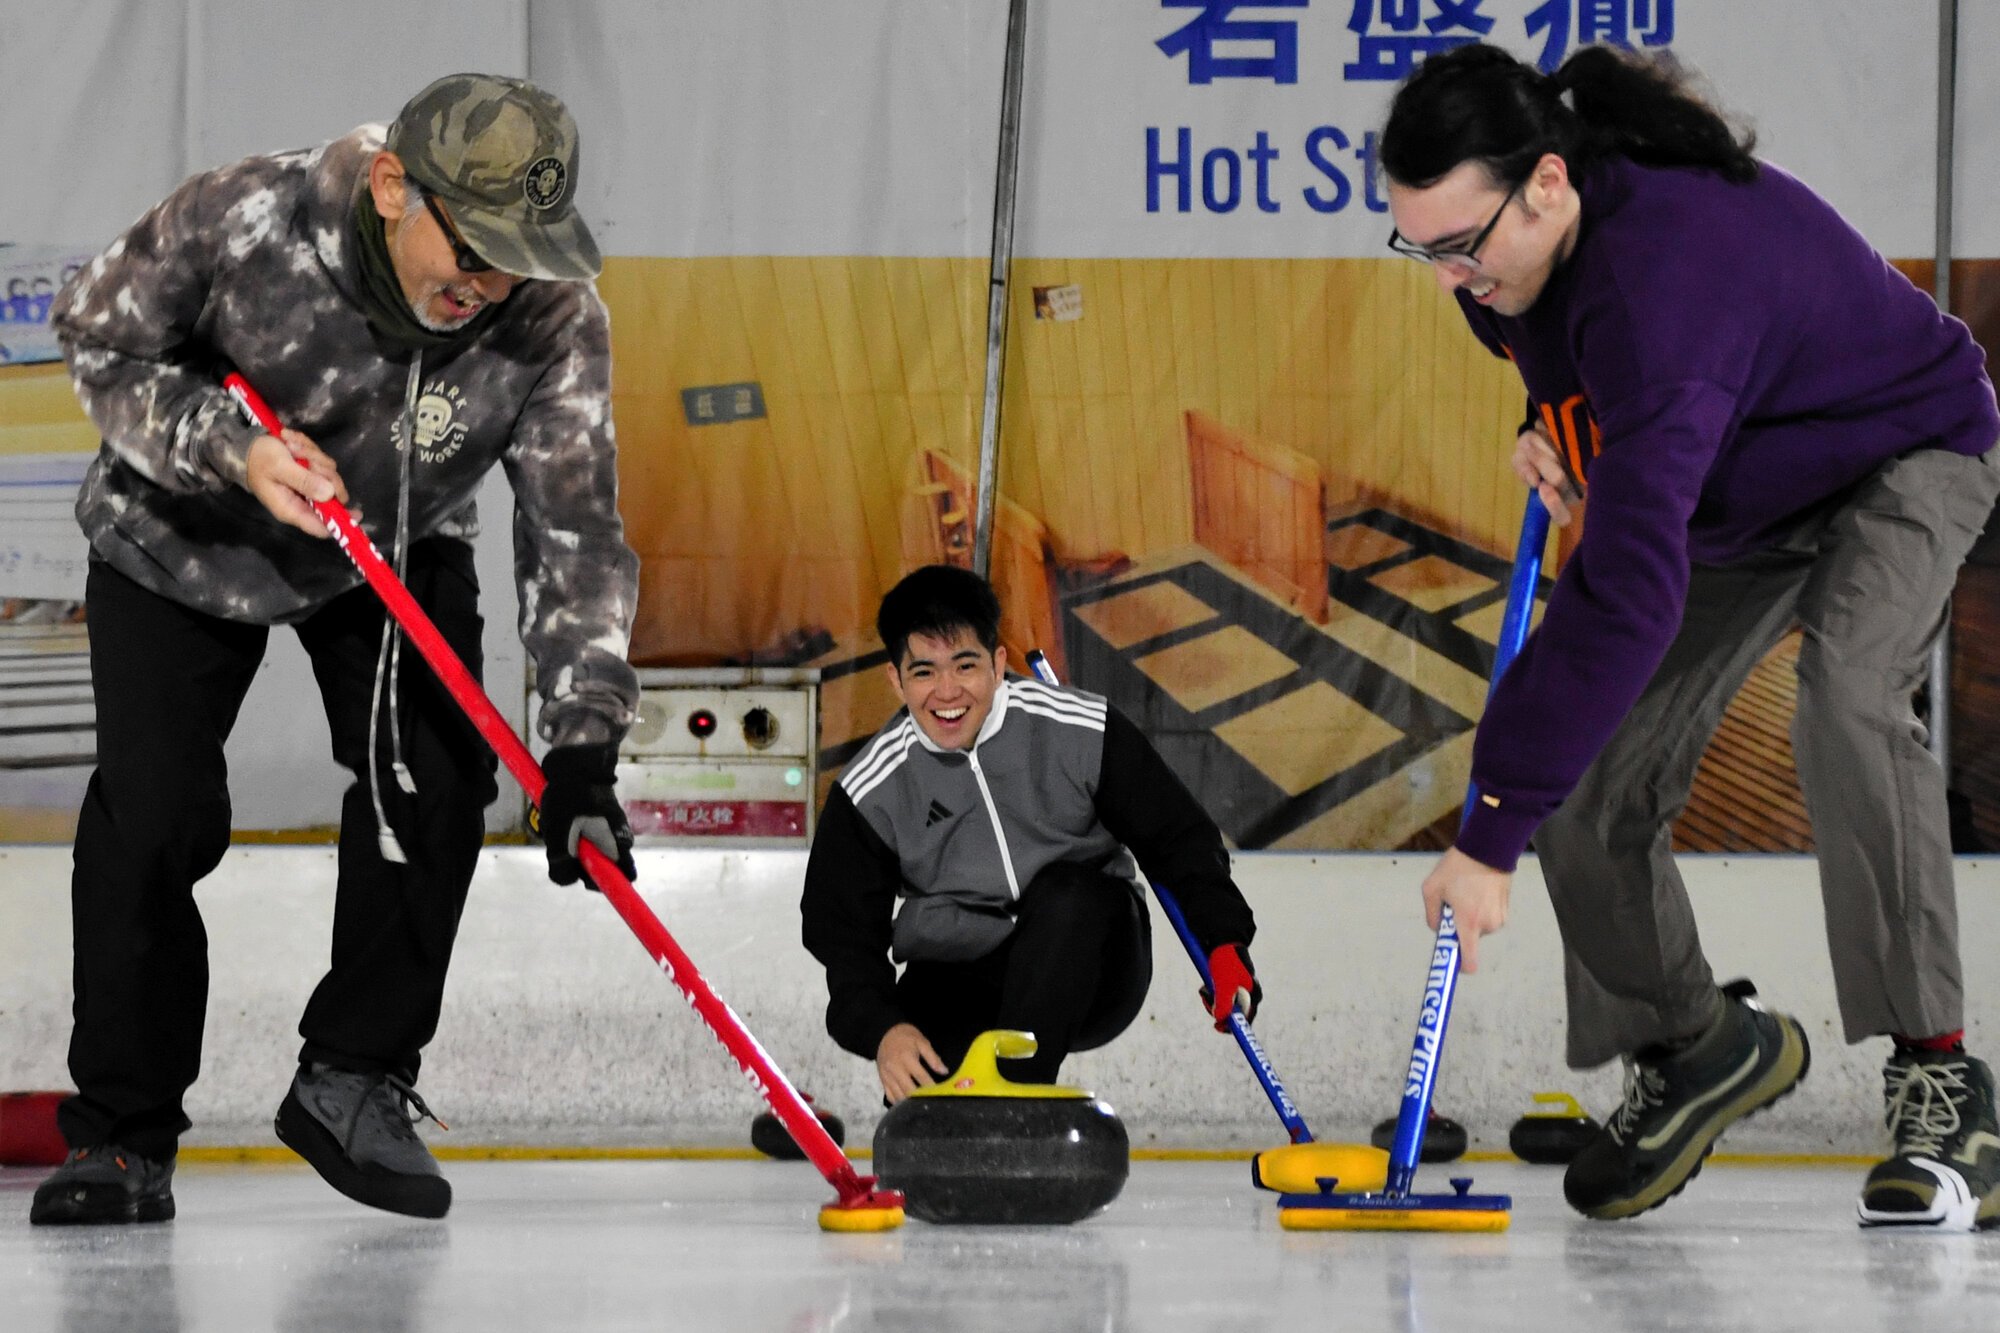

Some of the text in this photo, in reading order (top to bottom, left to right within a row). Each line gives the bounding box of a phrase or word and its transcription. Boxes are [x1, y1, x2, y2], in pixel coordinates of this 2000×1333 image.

[1145, 125, 1391, 214] Hot St
[420, 432, 465, 464] WORKS
